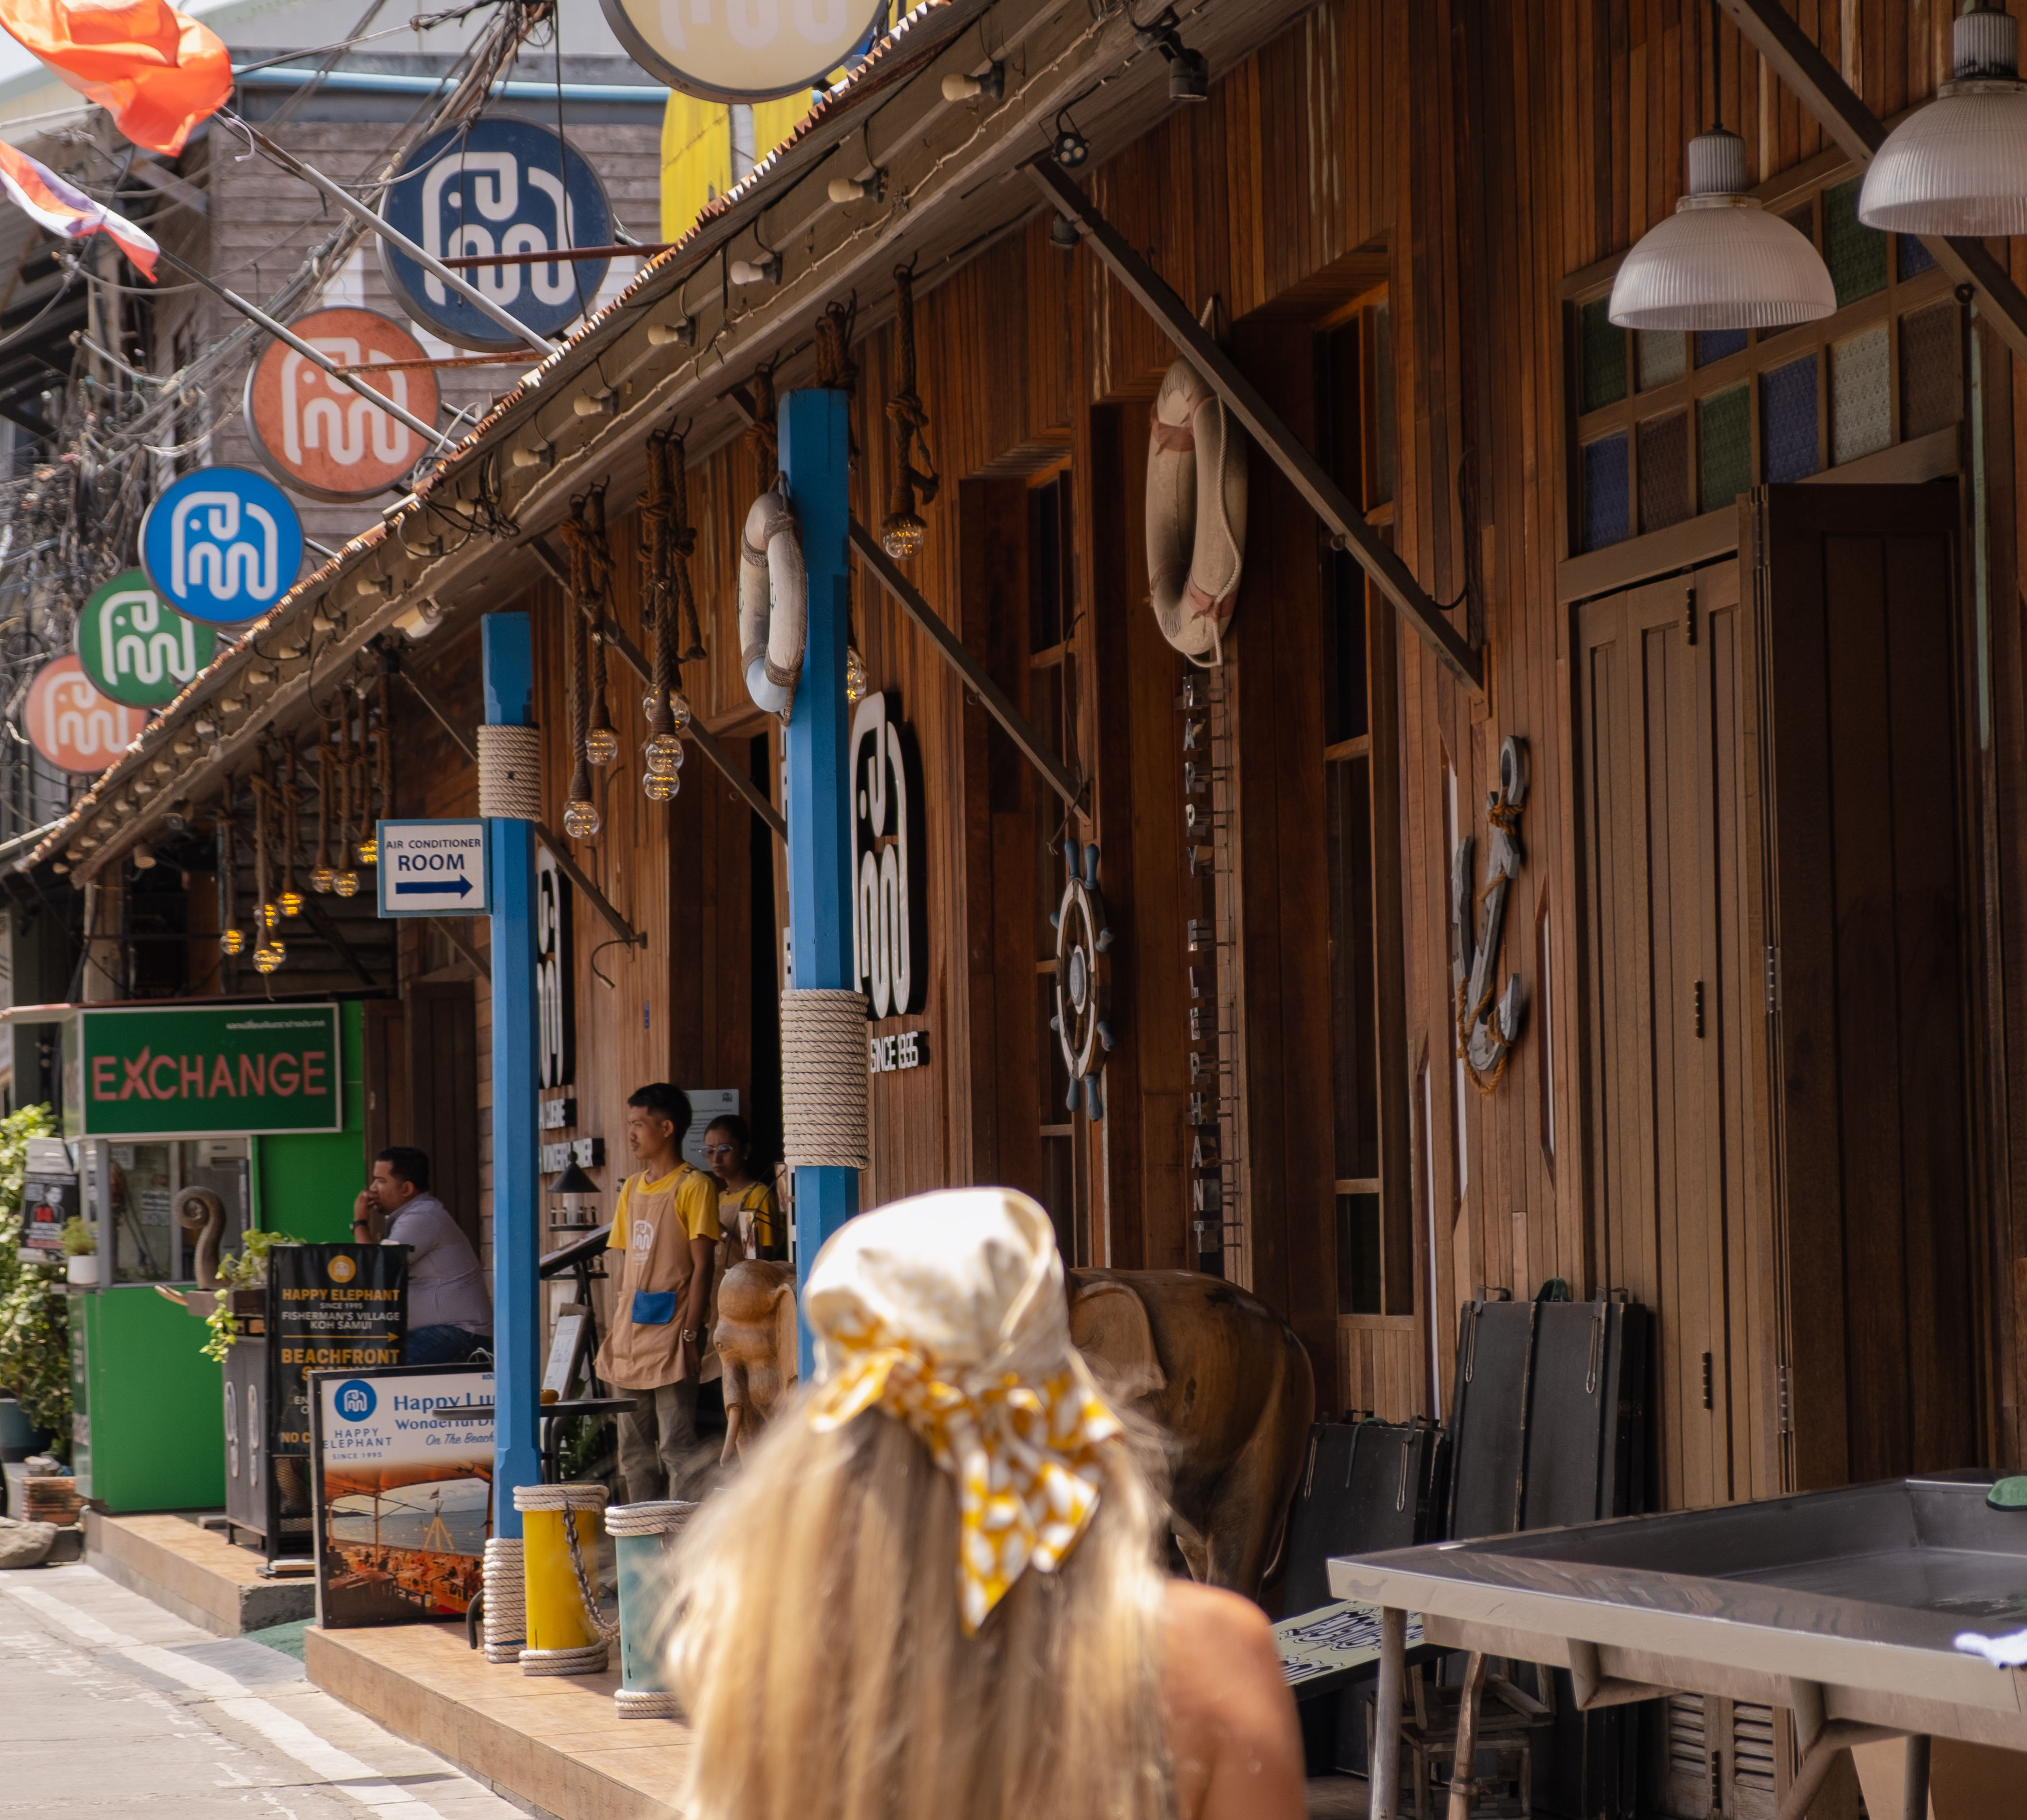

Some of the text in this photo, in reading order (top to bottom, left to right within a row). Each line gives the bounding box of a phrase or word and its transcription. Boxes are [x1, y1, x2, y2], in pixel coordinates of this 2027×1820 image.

[385, 838, 481, 849] AIR CONDITIONER
[398, 853, 465, 872] ROOM
[870, 1035, 896, 1073] SINCE
[92, 1045, 327, 1101] EXCHANGE
[282, 1288, 401, 1301] HAPPY ELEPHANT
[281, 1311, 401, 1321] FISHERMAN'S VILLAGE
[310, 1321, 372, 1329] KOH SAMUI
[281, 1348, 401, 1364] BEACHFRONT
[281, 1432, 300, 1443] NO
[334, 1428, 380, 1438] HAPPY
[425, 1434, 441, 1445] On
[444, 1433, 461, 1444] The
[324, 1437, 393, 1449] ELEPHANT
